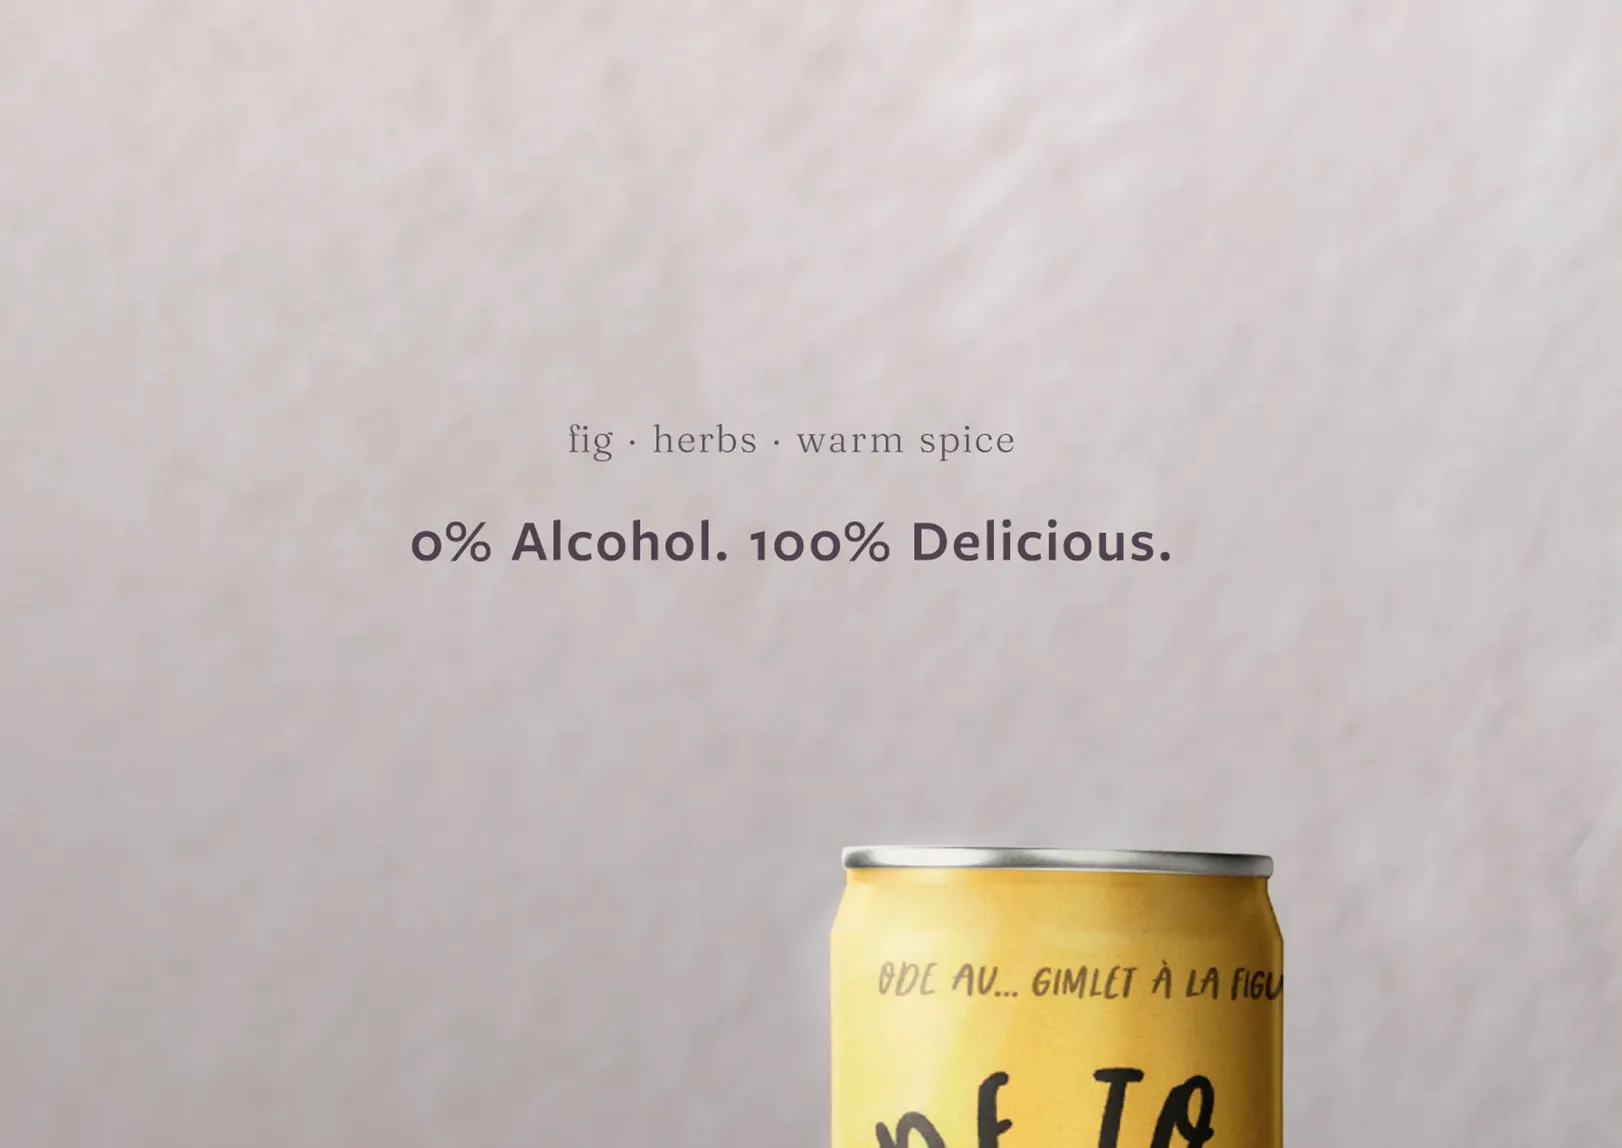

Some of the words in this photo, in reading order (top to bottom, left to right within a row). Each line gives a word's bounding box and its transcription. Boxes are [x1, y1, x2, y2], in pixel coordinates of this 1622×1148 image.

[879, 961, 938, 997] ODE
[952, 963, 1018, 997] AU...
[1032, 965, 1138, 1000] GIMLET
[1151, 959, 1172, 999] À
[1185, 967, 1219, 1000] LA
